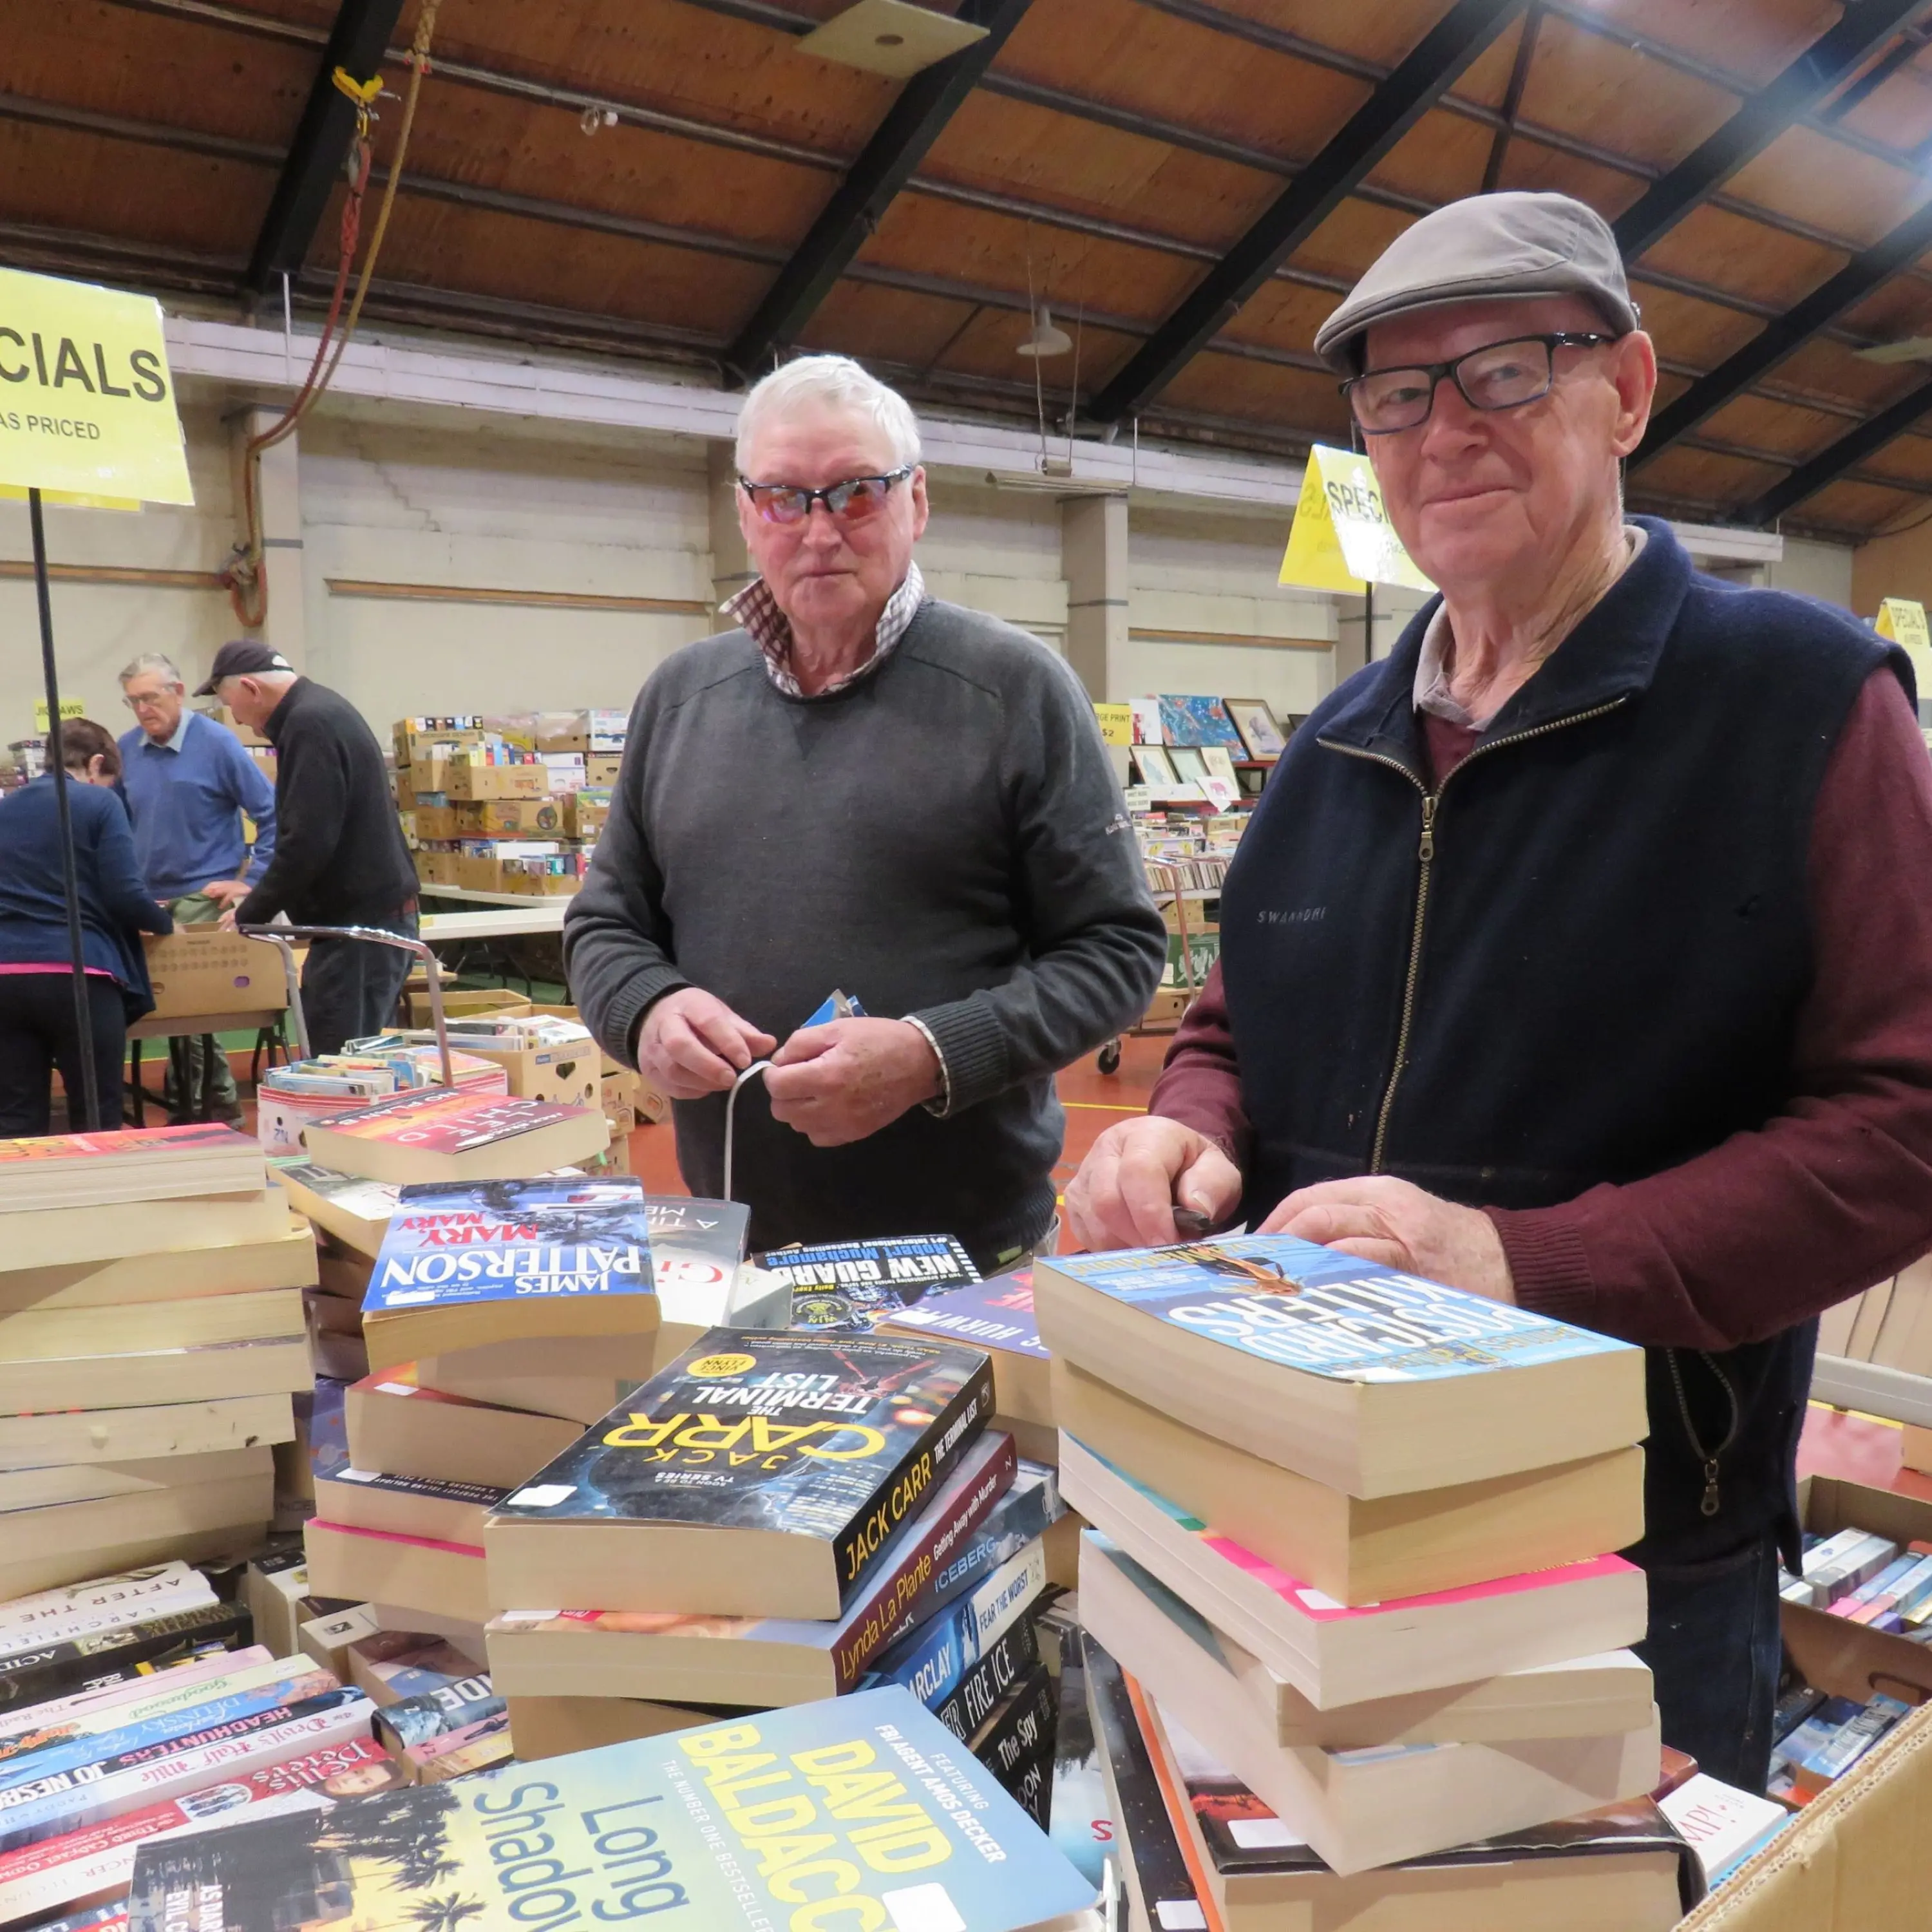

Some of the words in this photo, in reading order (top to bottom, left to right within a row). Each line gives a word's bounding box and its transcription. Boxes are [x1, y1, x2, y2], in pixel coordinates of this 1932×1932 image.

[26, 415, 100, 439] PRICED
[1110, 714, 1130, 723] PRINT
[1102, 729, 1115, 737] $2
[359, 1101, 423, 1120] PLAN
[424, 1092, 459, 1101] NO
[395, 1212, 484, 1231] MARY
[696, 1219, 719, 1229] A
[767, 1247, 880, 1266] Muchamore
[883, 1243, 950, 1259] Robert
[379, 1244, 641, 1289] PATTERSON
[887, 1254, 960, 1278] NEW
[515, 1269, 610, 1294] JAMES
[1166, 1273, 1466, 1343] KILLERS
[1236, 1294, 1543, 1363] POSTCARD
[754, 1372, 840, 1391] LIST
[692, 1385, 869, 1414] TERMINAL
[746, 1404, 783, 1417] THE
[603, 1412, 886, 1461] CARR
[642, 1446, 790, 1470] JACK
[655, 1472, 712, 1481] SERIES
[846, 1502, 891, 1580] JACK
[891, 1452, 932, 1520] CARR
[934, 1440, 946, 1464] THE
[944, 1414, 969, 1452] TERMINAL
[966, 1397, 978, 1425] LIST
[841, 1619, 878, 1680] Lynda
[879, 1602, 896, 1632] La
[896, 1553, 932, 1609] Plante
[933, 1531, 955, 1562] Getting
[953, 1510, 969, 1538] Away
[967, 1494, 980, 1520] with
[978, 1473, 998, 1504] Murder
[934, 1537, 998, 1593] ICEBERG
[90, 1577, 180, 1605] AFTER
[980, 1607, 997, 1634] FEAR
[996, 1592, 1009, 1618] THE
[1008, 1569, 1030, 1604] WORST
[19, 1604, 78, 1624] THE
[963, 1663, 995, 1729] FIRE
[992, 1638, 1016, 1694] ICE
[140, 1695, 242, 1735] DELINSKY
[118, 1706, 292, 1766] HEADHUNTERS
[998, 1734, 1021, 1771] The
[1017, 1710, 1039, 1748] Spy
[200, 1739, 252, 1767] Half
[251, 1739, 374, 1786] Peters
[72, 1761, 108, 1786] JO
[140, 1758, 196, 1786] Mile
[928, 1752, 990, 1810] FEATURING
[661, 1759, 685, 1780] THE
[674, 1779, 711, 1824] NUMBER
[699, 1824, 726, 1853] ONE
[789, 1739, 953, 1874] DAVID
[874, 1723, 903, 1746] FBI
[890, 1740, 937, 1779] AGENT
[920, 1775, 963, 1817] AMOS
[949, 1810, 1007, 1864] DECKER
[580, 1794, 691, 1924] Long
[165, 1891, 189, 1921] EVIL
[200, 1884, 223, 1901] AS
